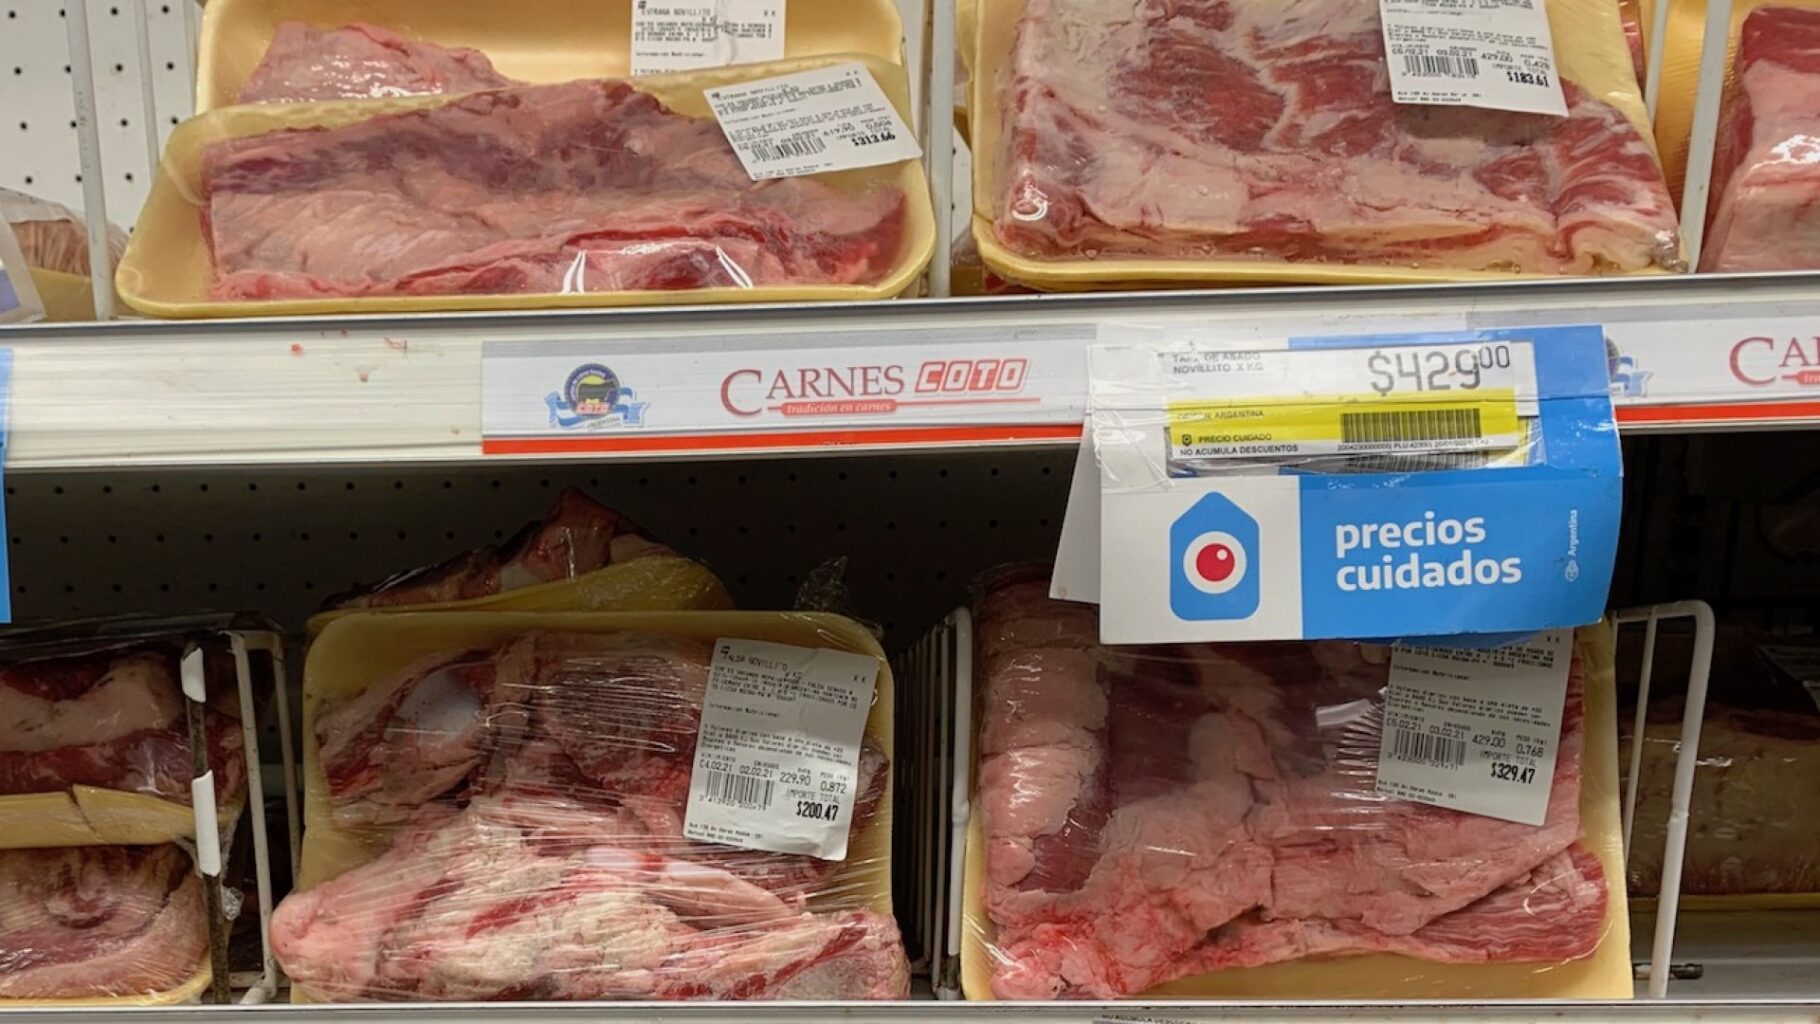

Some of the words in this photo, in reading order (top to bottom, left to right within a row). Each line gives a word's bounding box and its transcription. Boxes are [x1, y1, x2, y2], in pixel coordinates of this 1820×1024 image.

[1173, 363, 1231, 375] NOVILLITO
[1729, 336, 1820, 386] CA
[720, 365, 905, 417] CARNES
[914, 358, 1027, 394] COTO
[786, 402, 839, 415] tradición
[841, 403, 853, 412] en
[855, 403, 892, 412] carnes
[1214, 410, 1264, 419] ARGENTINA
[1233, 433, 1272, 442] CUIDADO
[1195, 447, 1238, 456] ACUMULA
[1239, 444, 1298, 454] DESCUENTOS
[1336, 511, 1486, 558] precios
[1567, 509, 1579, 556] Argentina
[1336, 549, 1522, 590] cuidados
[1472, 733, 1506, 748] 429.00
[1516, 743, 1544, 758] 0.768
[779, 771, 812, 787] 229.90
[820, 780, 847, 795] 0.872
[1490, 762, 1536, 785] $329.47
[796, 800, 840, 822] $200.47
